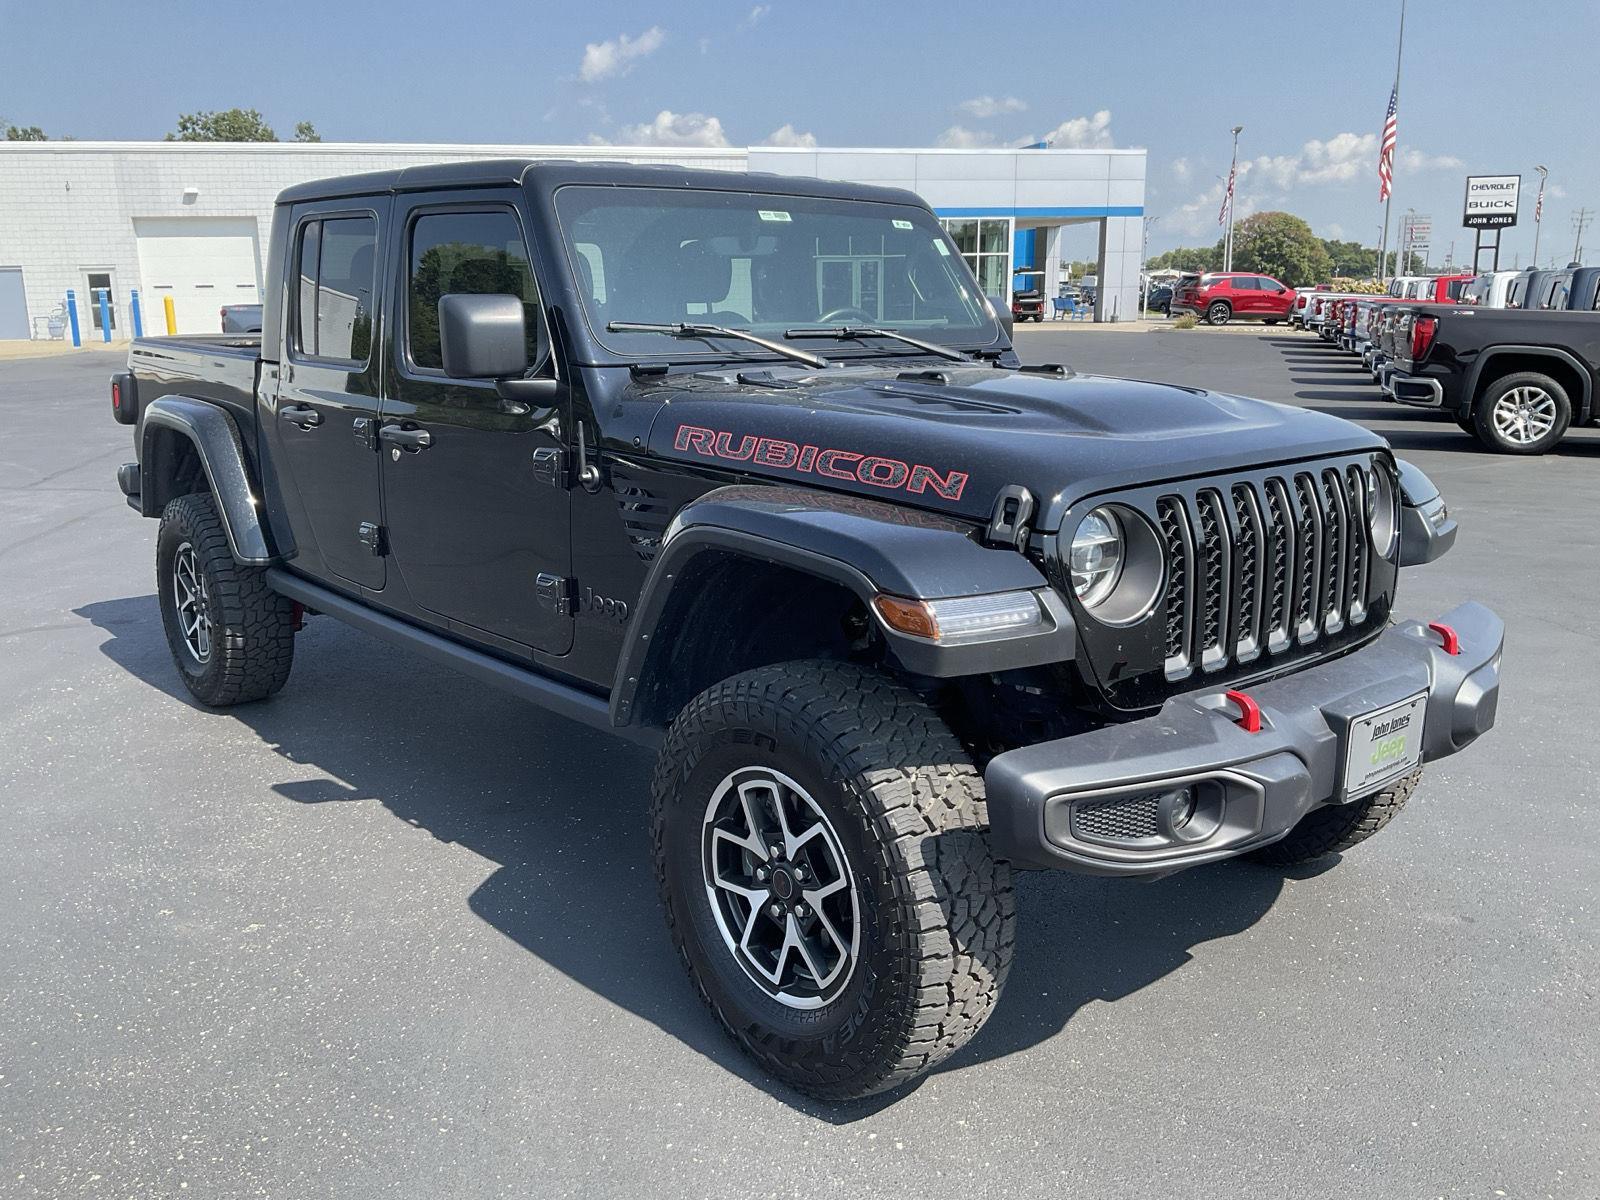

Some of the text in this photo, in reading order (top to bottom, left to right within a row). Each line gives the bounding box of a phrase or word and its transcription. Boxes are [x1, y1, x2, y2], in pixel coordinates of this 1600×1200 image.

[1471, 183, 1516, 191] CHEVROLET
[1469, 200, 1515, 208] BUICK
[1489, 216, 1513, 224] JONES
[673, 425, 969, 501] RUBICON
[580, 586, 628, 624] Jeep
[1371, 714, 1411, 741] John Jones
[1370, 735, 1407, 765] Jeep
